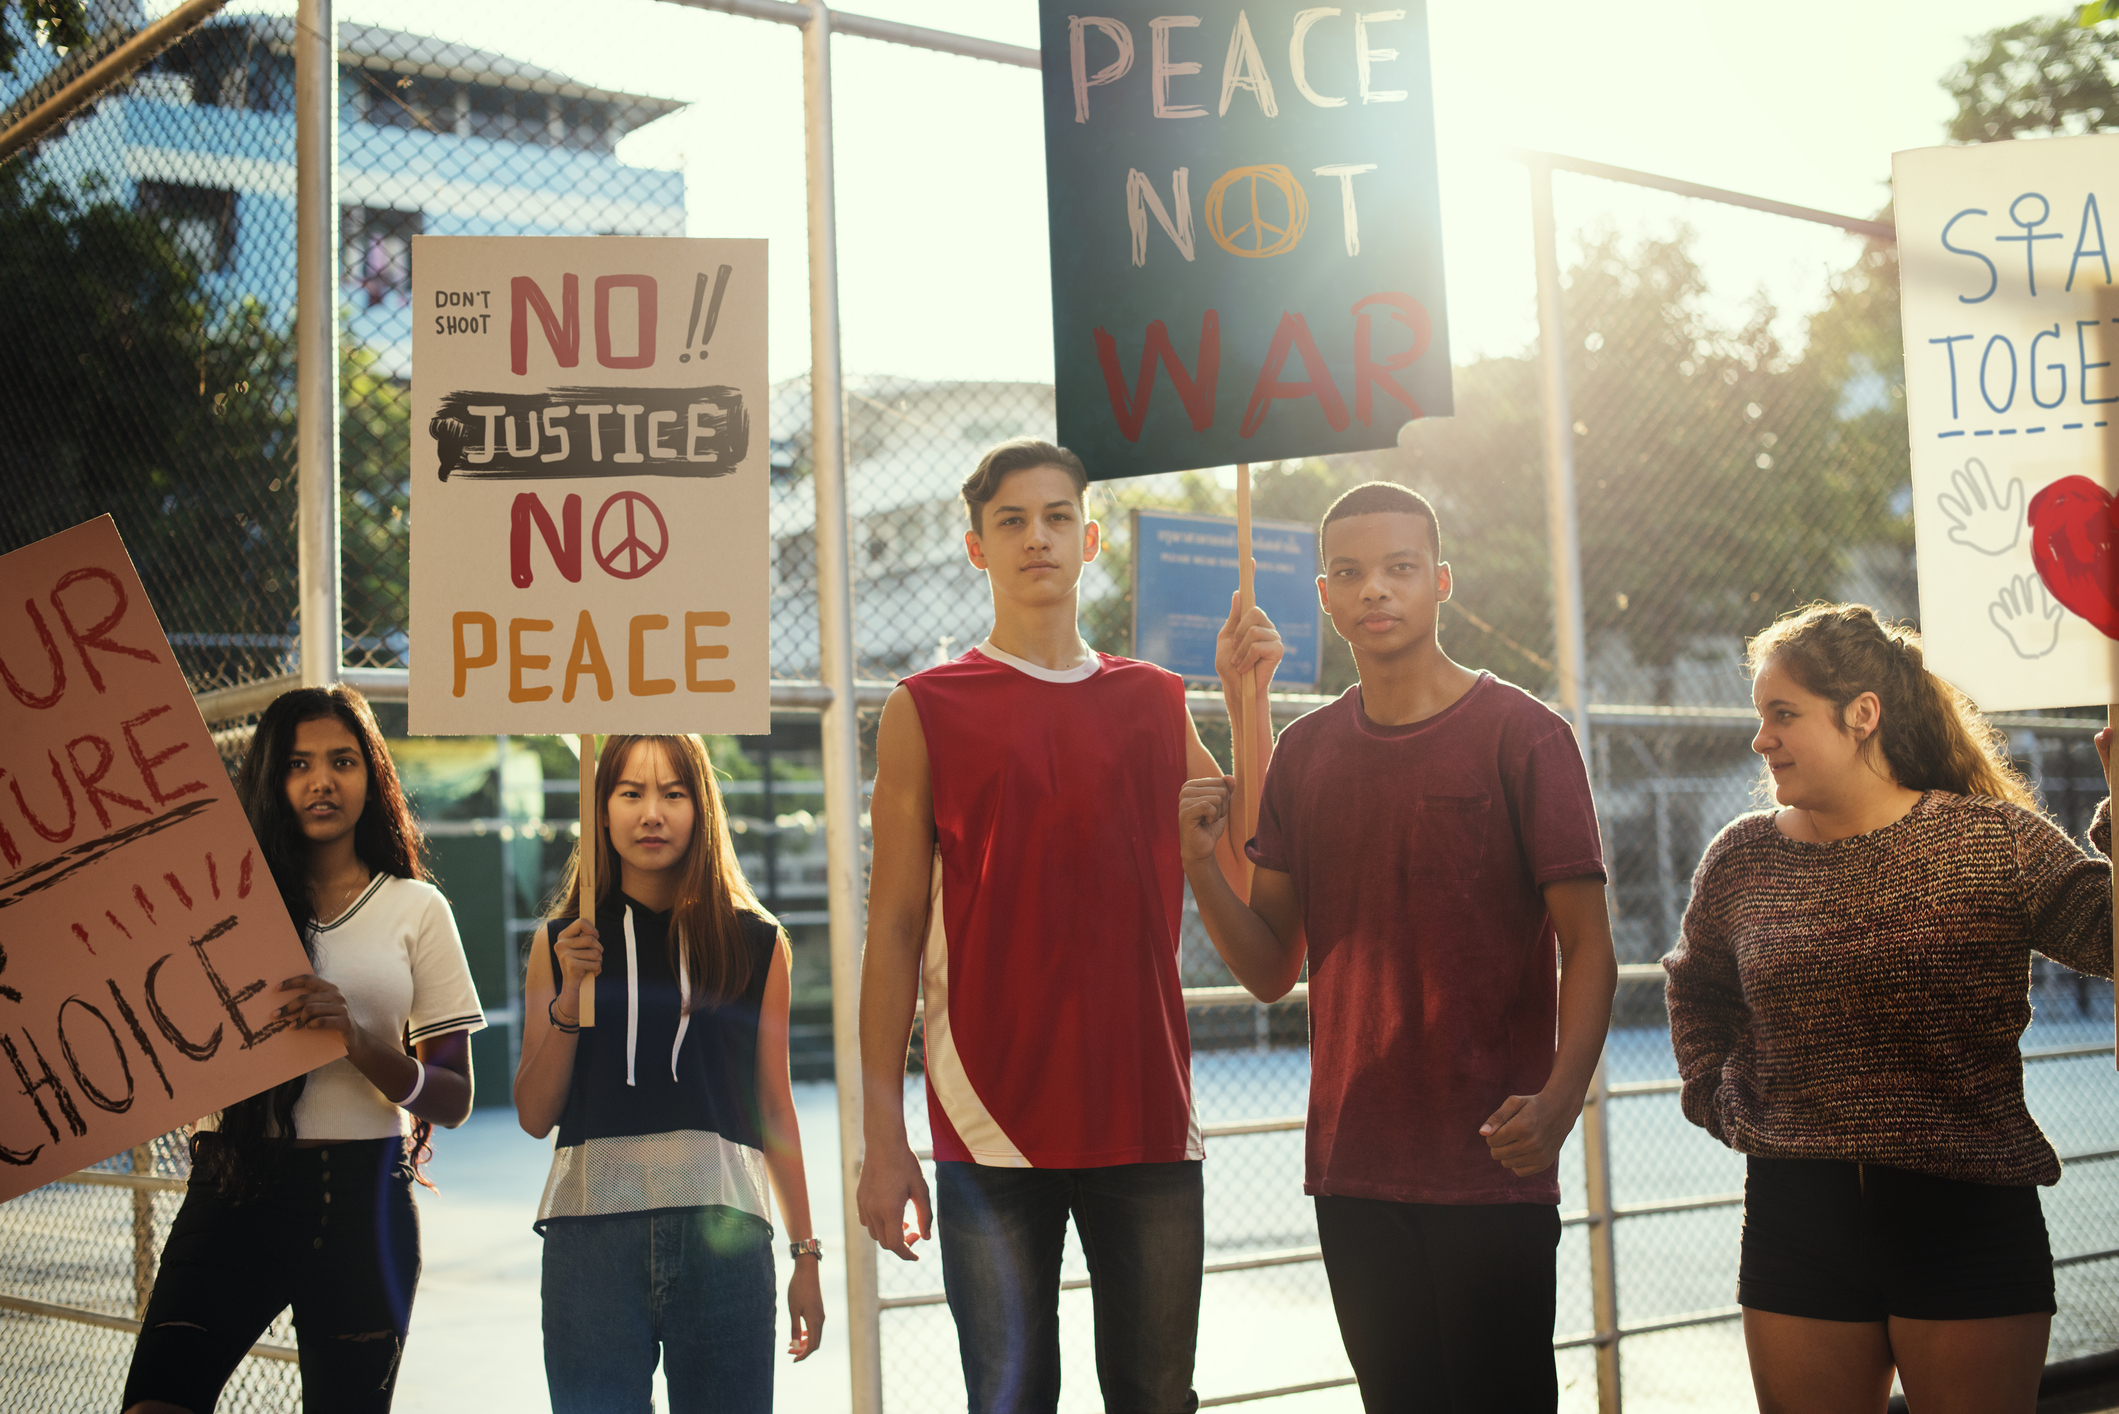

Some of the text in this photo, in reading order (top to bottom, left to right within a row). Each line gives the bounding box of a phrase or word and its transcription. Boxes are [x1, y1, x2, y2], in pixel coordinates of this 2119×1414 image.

[1067, 6, 1409, 124] PEACE
[434, 290, 491, 310] DON'T
[434, 314, 491, 335] SHOOT
[1091, 291, 1433, 443] WAR
[1928, 317, 2119, 420] TOGE
[466, 403, 720, 463] JUSTICE
[451, 609, 736, 704] PEACE
[0, 914, 292, 1166] HOICE
